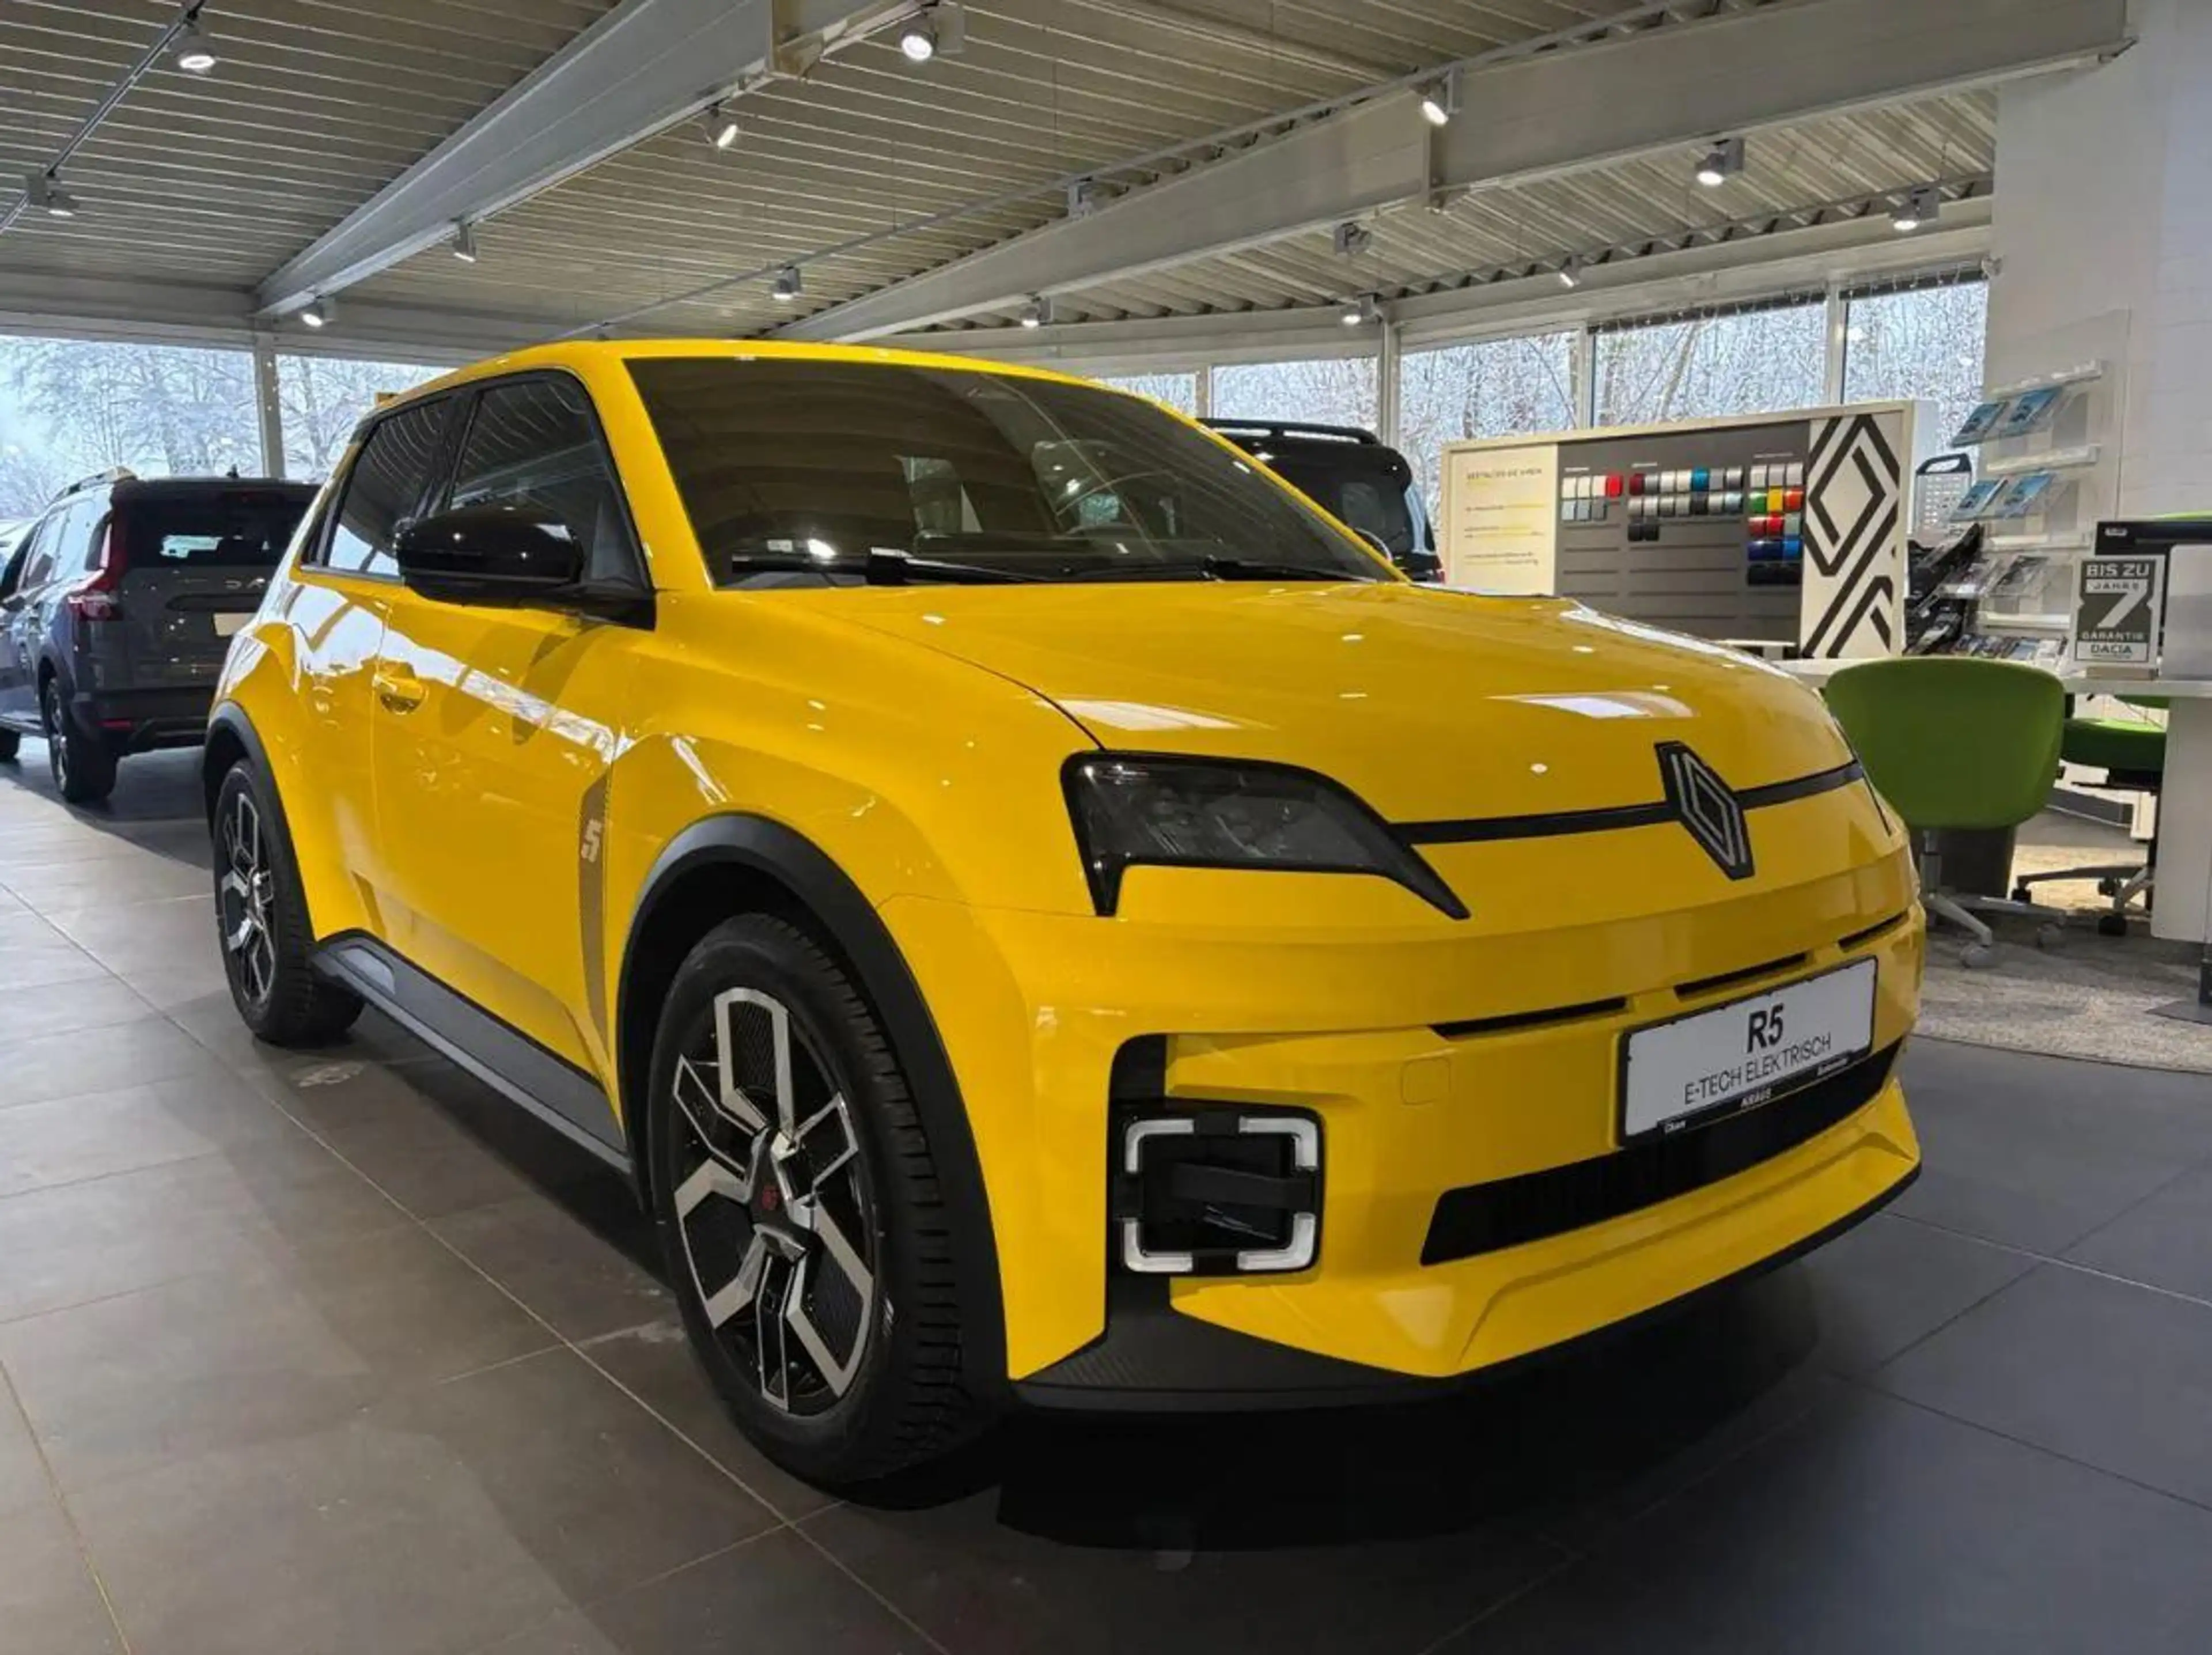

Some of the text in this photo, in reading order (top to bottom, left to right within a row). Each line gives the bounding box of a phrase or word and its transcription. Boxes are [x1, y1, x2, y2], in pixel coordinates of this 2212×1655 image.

[2086, 562, 2150, 577] BIS ZU
[2085, 578, 2149, 629] 7
[2090, 643, 2133, 654] DACIA
[1747, 1002, 1784, 1054] R5
[1684, 1066, 1742, 1105] E-TECH
[1745, 1031, 1832, 1083] ELEKTRISCH
